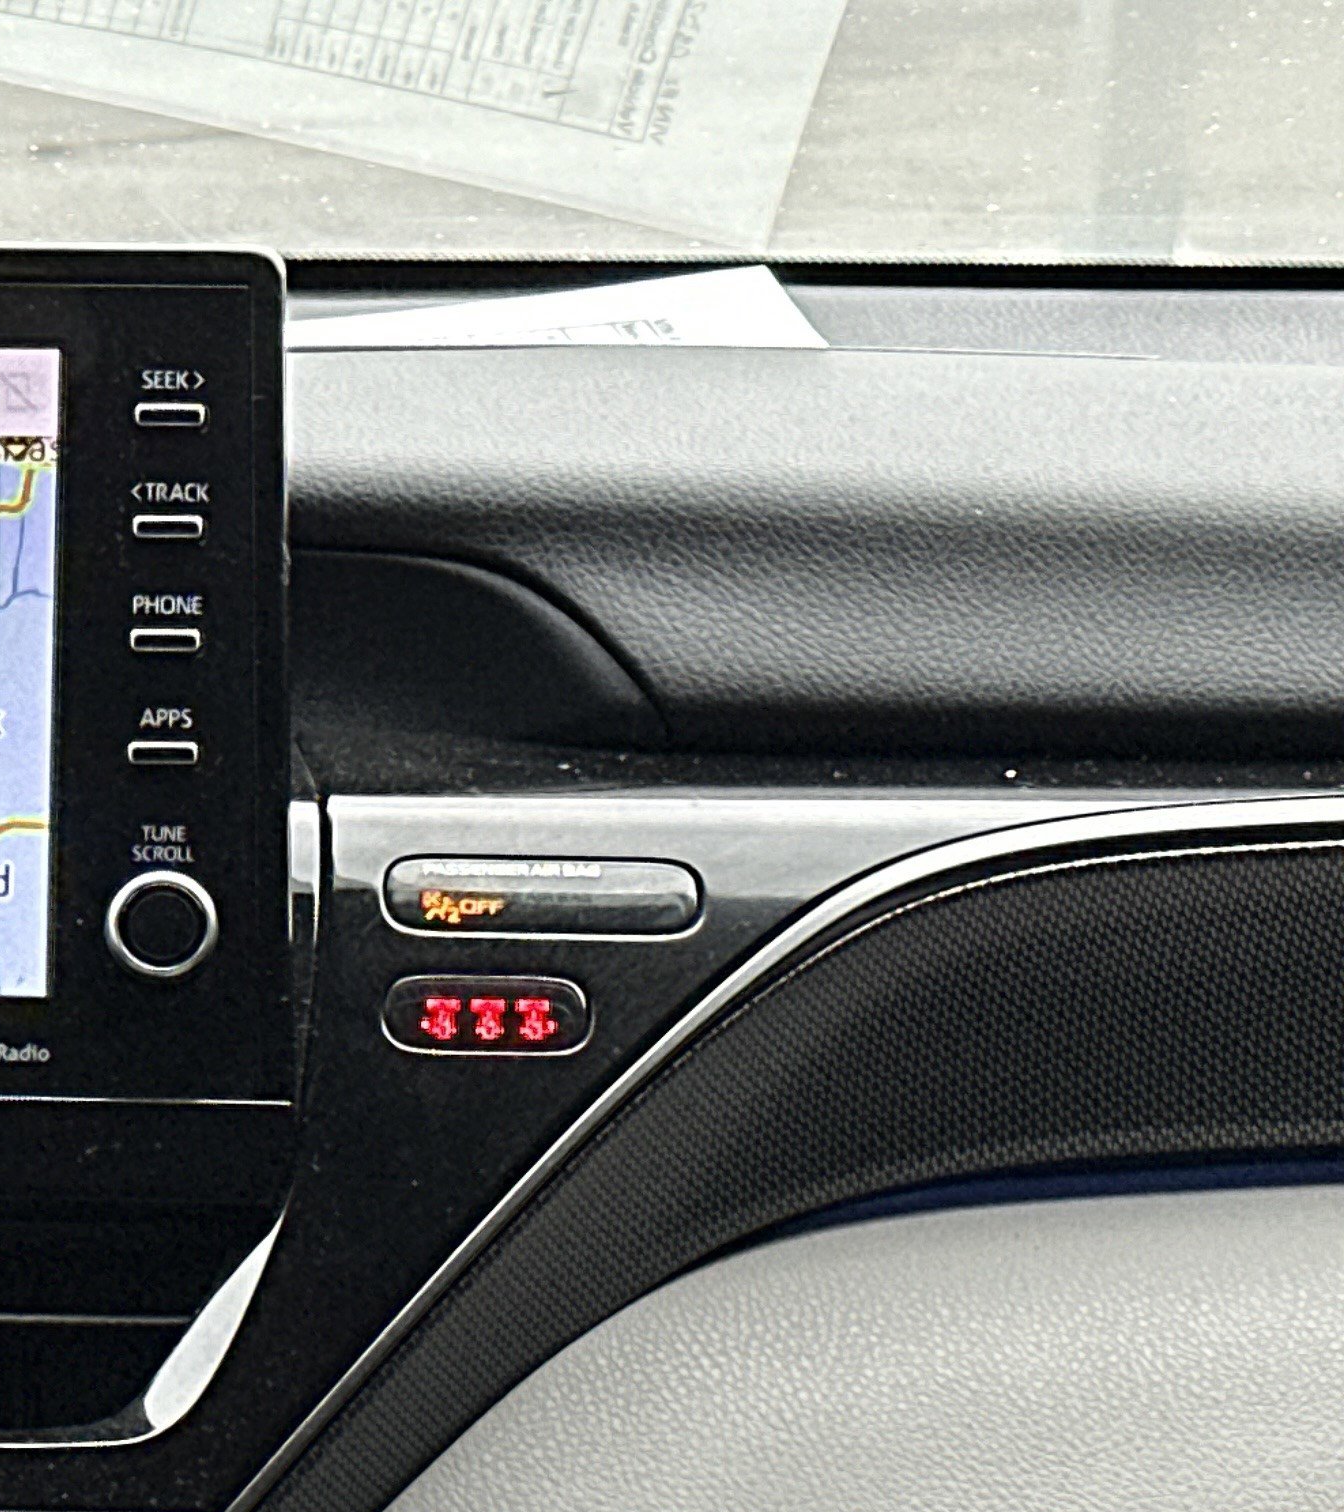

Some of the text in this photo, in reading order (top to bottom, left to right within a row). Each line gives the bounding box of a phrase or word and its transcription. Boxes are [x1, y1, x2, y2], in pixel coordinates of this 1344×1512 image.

[132, 596, 203, 615] PHONE
[141, 709, 193, 729] APPS
[142, 825, 187, 842] TUNE
[132, 844, 194, 864] SCROLL
[459, 899, 503, 915] OFF
